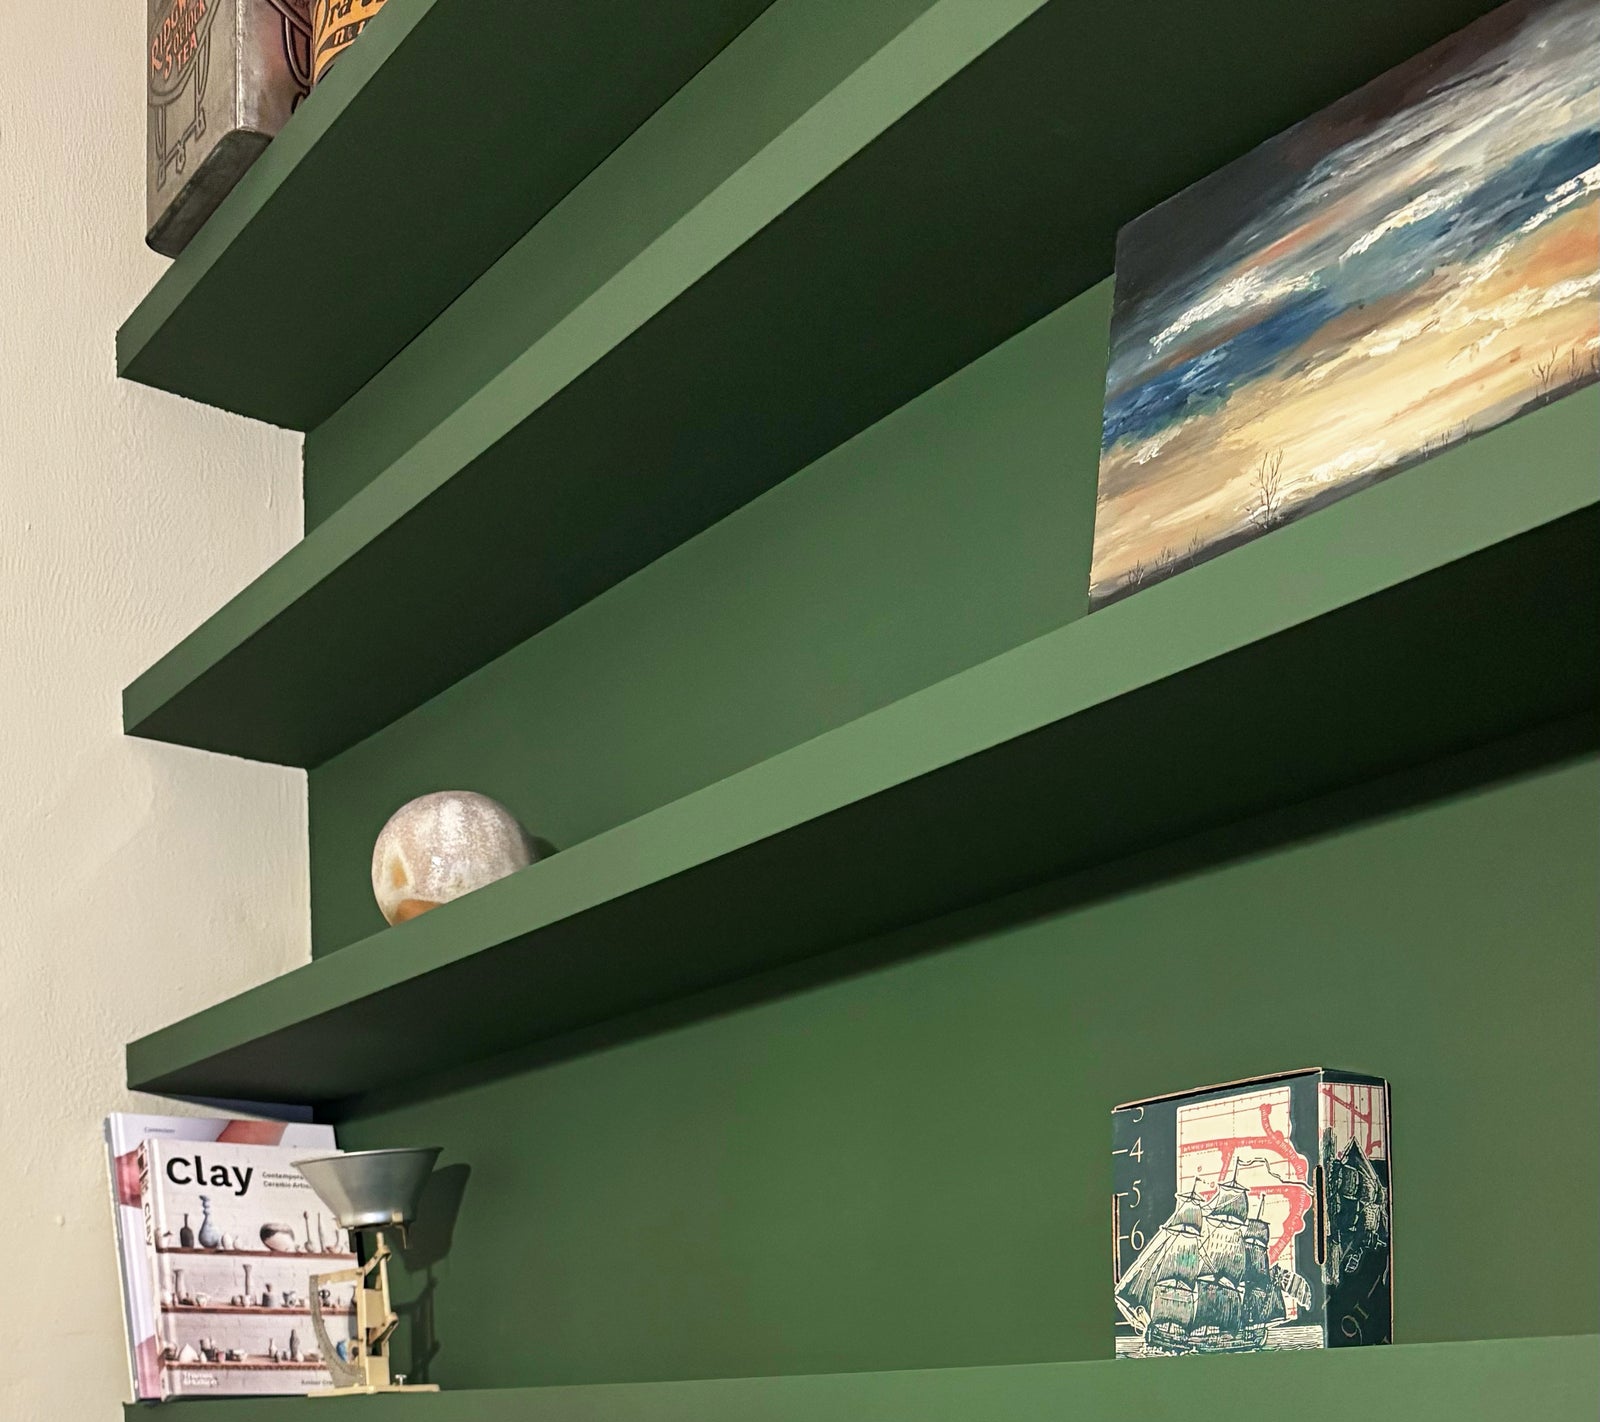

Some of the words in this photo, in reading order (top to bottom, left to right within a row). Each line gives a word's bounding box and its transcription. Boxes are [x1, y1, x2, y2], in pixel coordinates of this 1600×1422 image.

[177, 31, 198, 72] TEA
[1129, 1136, 1144, 1163] 4
[166, 1155, 254, 1196] Clay
[1129, 1179, 1143, 1209] 5
[144, 1203, 152, 1245] Clay
[1130, 1219, 1145, 1251] 6
